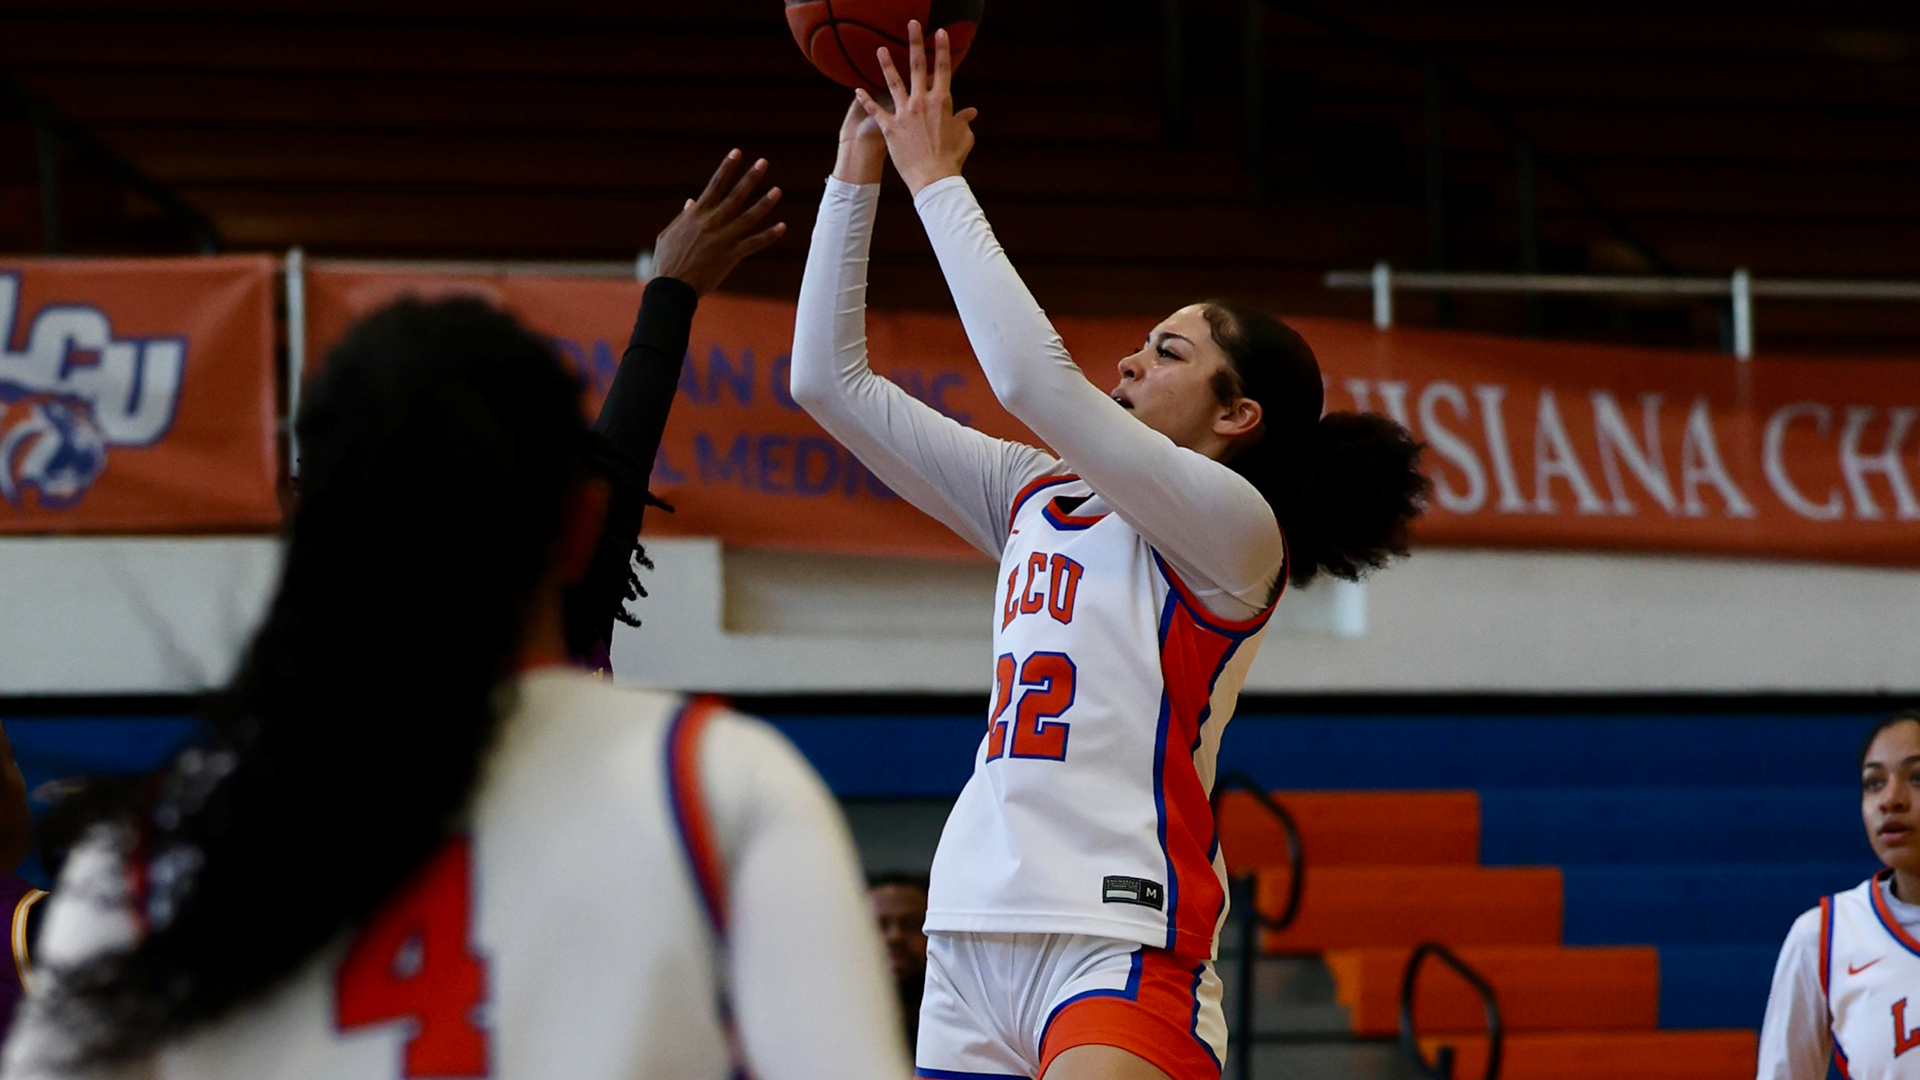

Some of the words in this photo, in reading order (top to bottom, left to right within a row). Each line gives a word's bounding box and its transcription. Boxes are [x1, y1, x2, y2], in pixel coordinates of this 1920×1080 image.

[1762, 401, 1920, 520] CH
[1001, 551, 1085, 634] LCU
[986, 651, 1077, 763] 22
[1146, 887, 1157, 899] M
[332, 832, 493, 1080] 4
